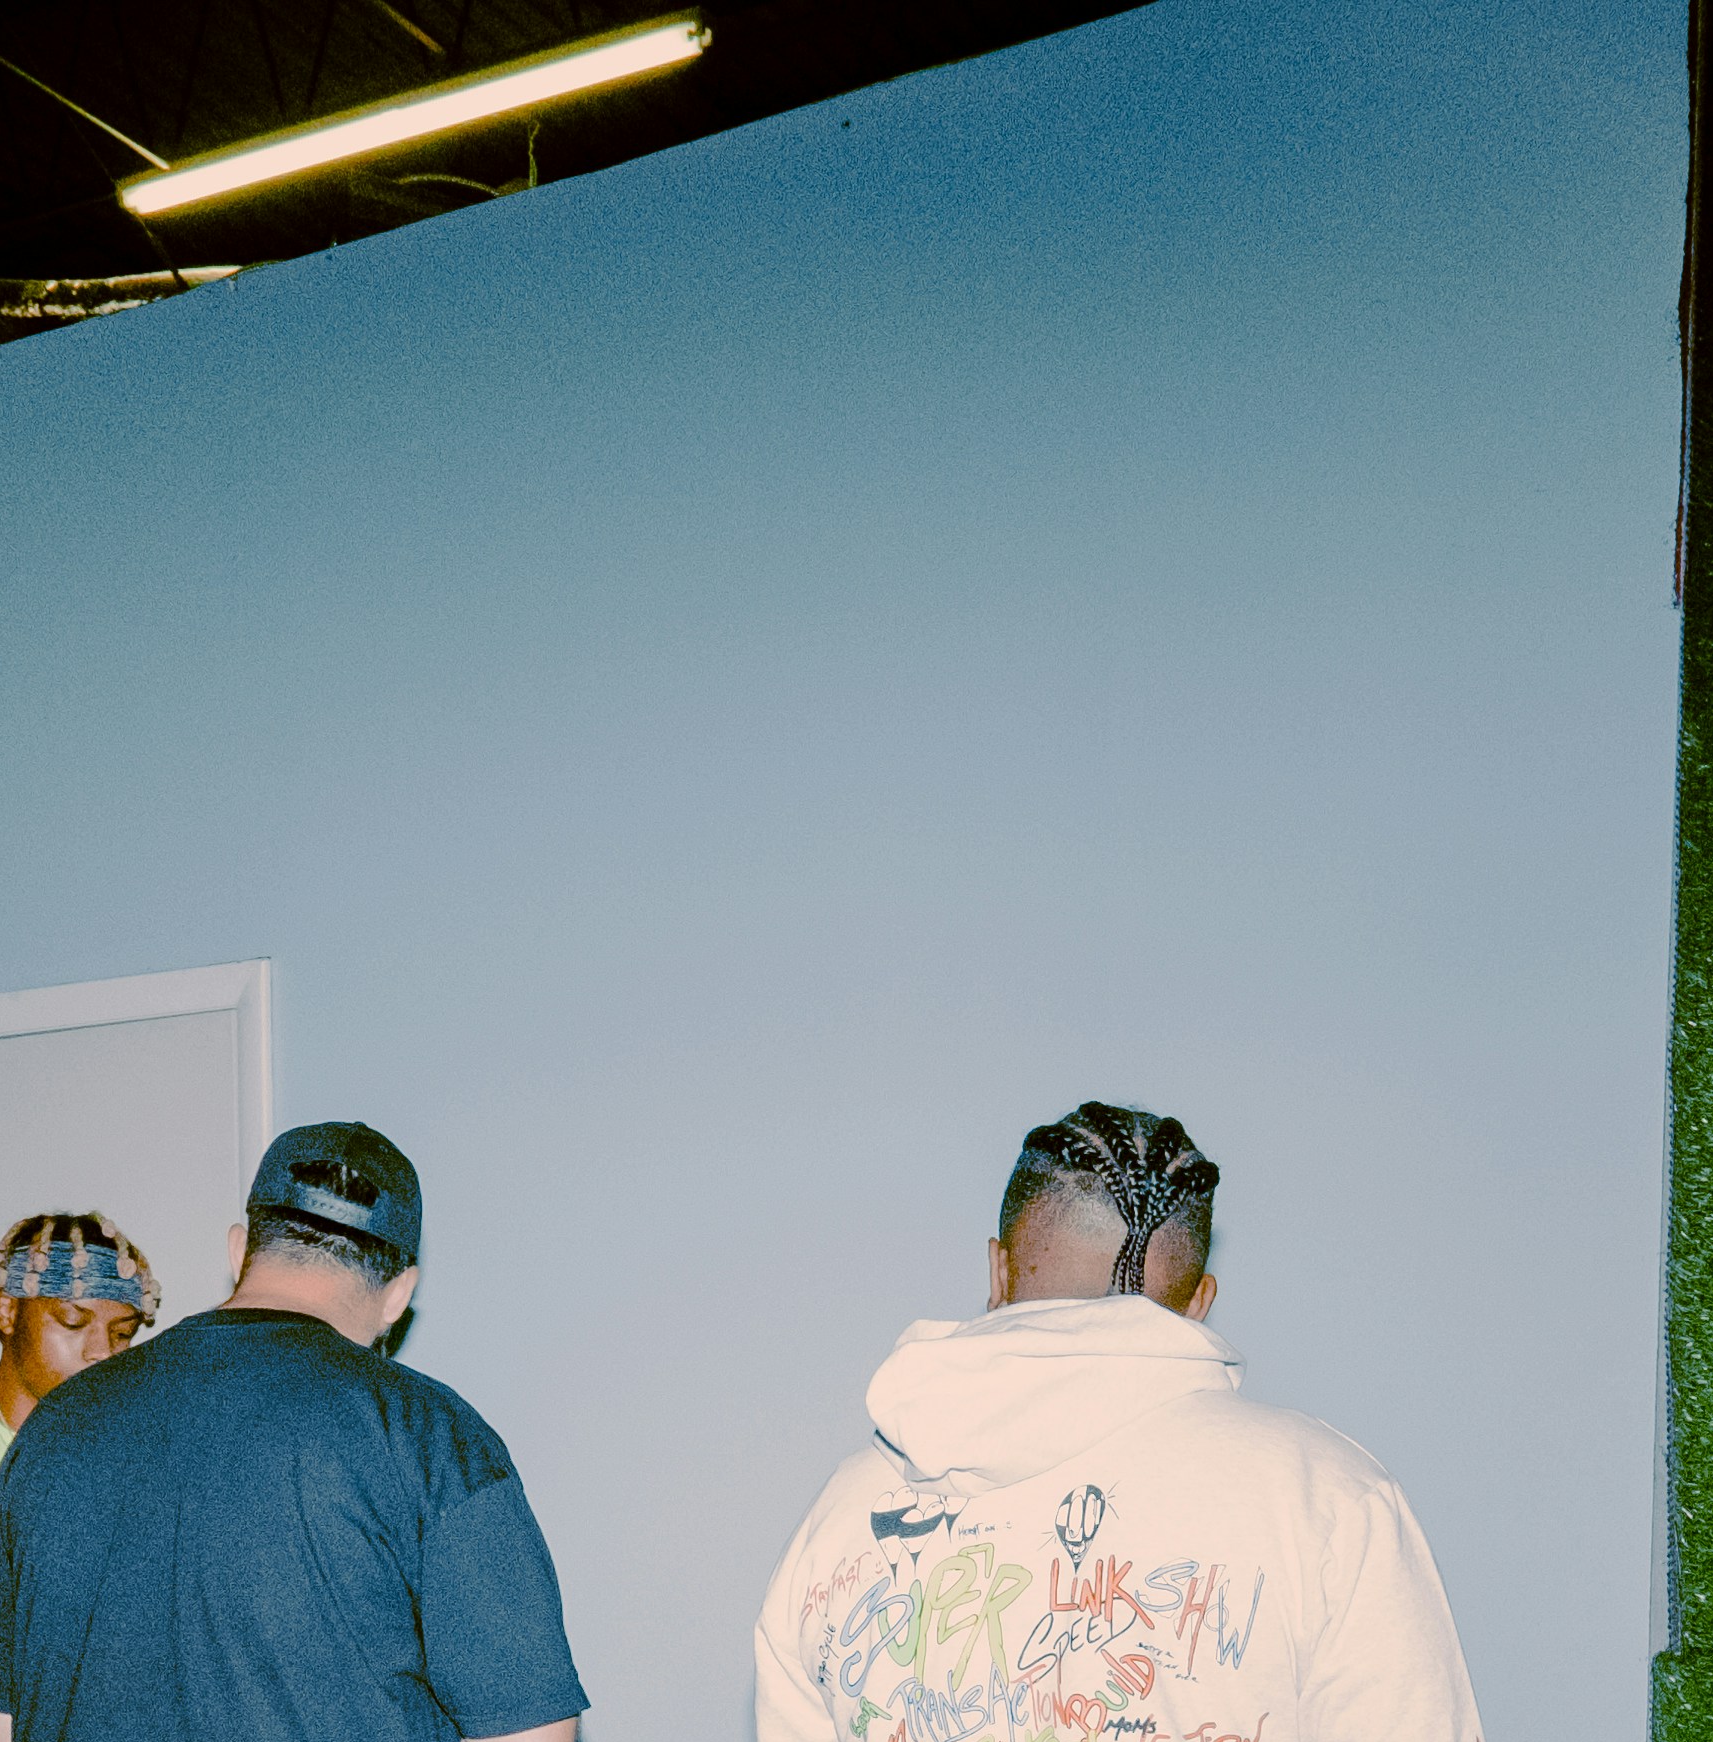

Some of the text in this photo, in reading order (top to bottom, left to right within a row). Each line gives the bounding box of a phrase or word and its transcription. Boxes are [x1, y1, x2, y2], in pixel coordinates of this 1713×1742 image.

[839, 1542, 1033, 1698] SUPER
[1049, 1554, 1265, 1677] LINK SHOW
